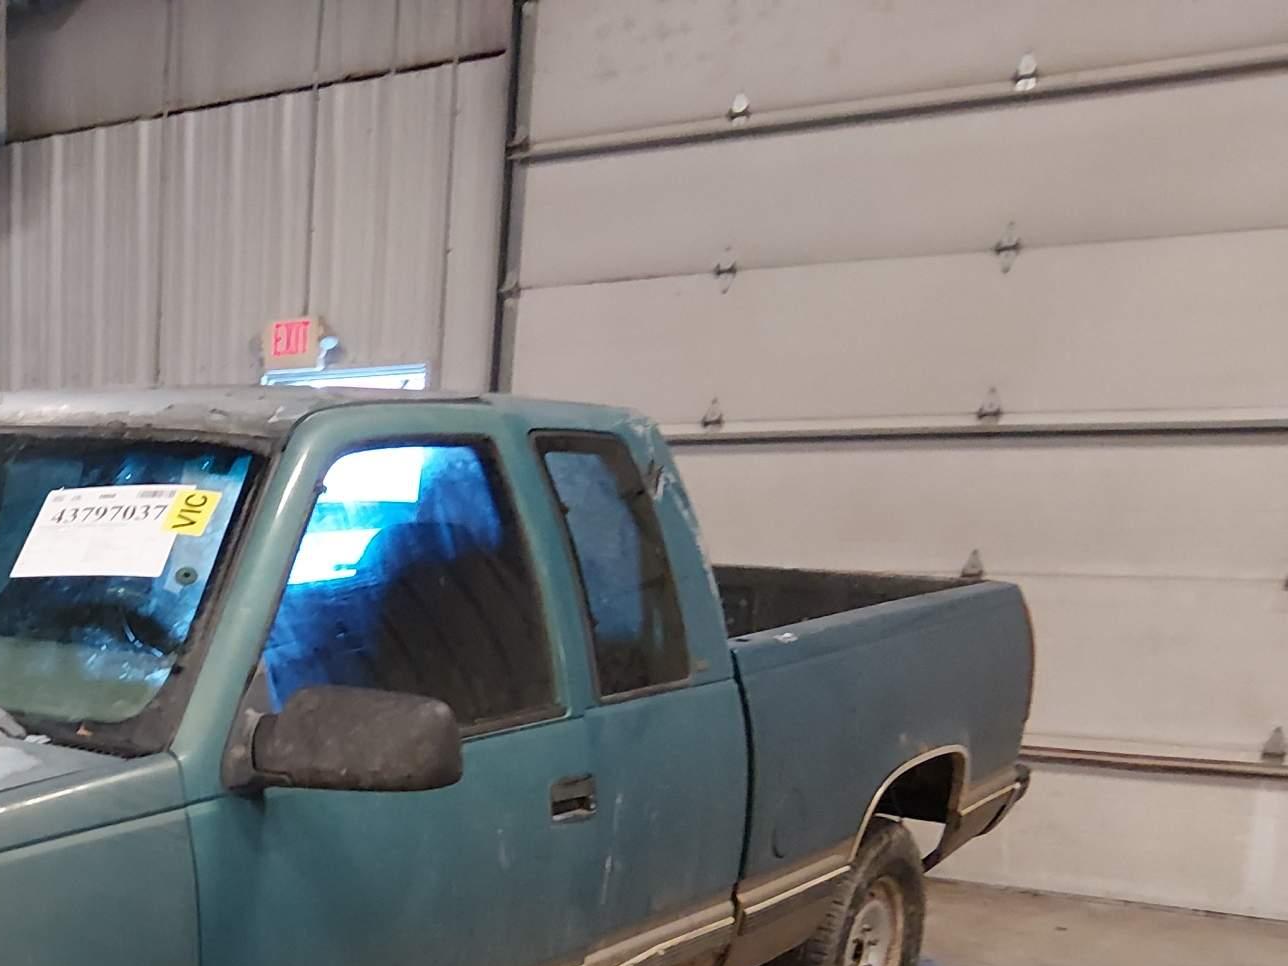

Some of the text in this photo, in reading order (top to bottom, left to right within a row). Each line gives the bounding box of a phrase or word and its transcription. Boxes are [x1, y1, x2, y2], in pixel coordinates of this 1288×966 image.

[273, 321, 310, 356] EXIT
[51, 504, 168, 523] 43797037
[172, 494, 208, 528] VIC
